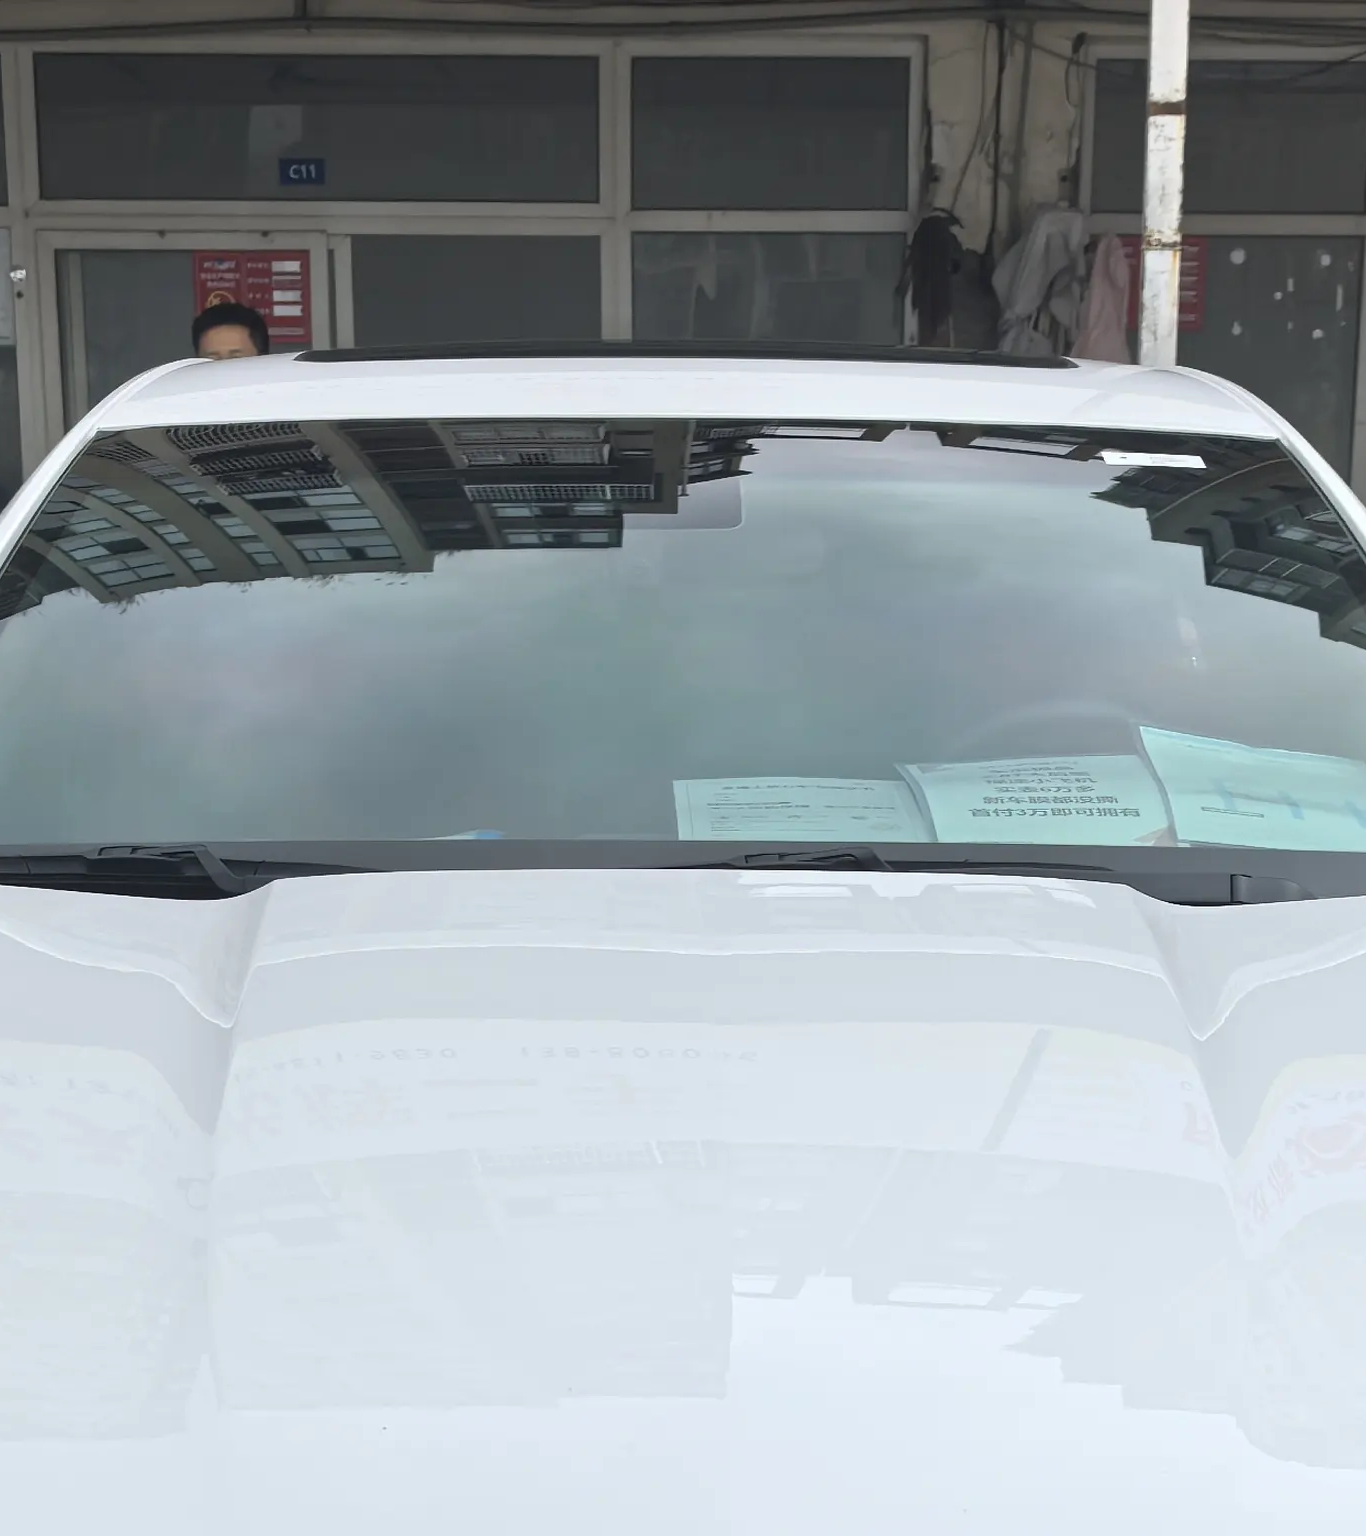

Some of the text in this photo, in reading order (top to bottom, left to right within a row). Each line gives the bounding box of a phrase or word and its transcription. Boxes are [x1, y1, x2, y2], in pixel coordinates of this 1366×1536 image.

[289, 164, 316, 179] C11
[968, 807, 1141, 818] 首付3万即可拥有
